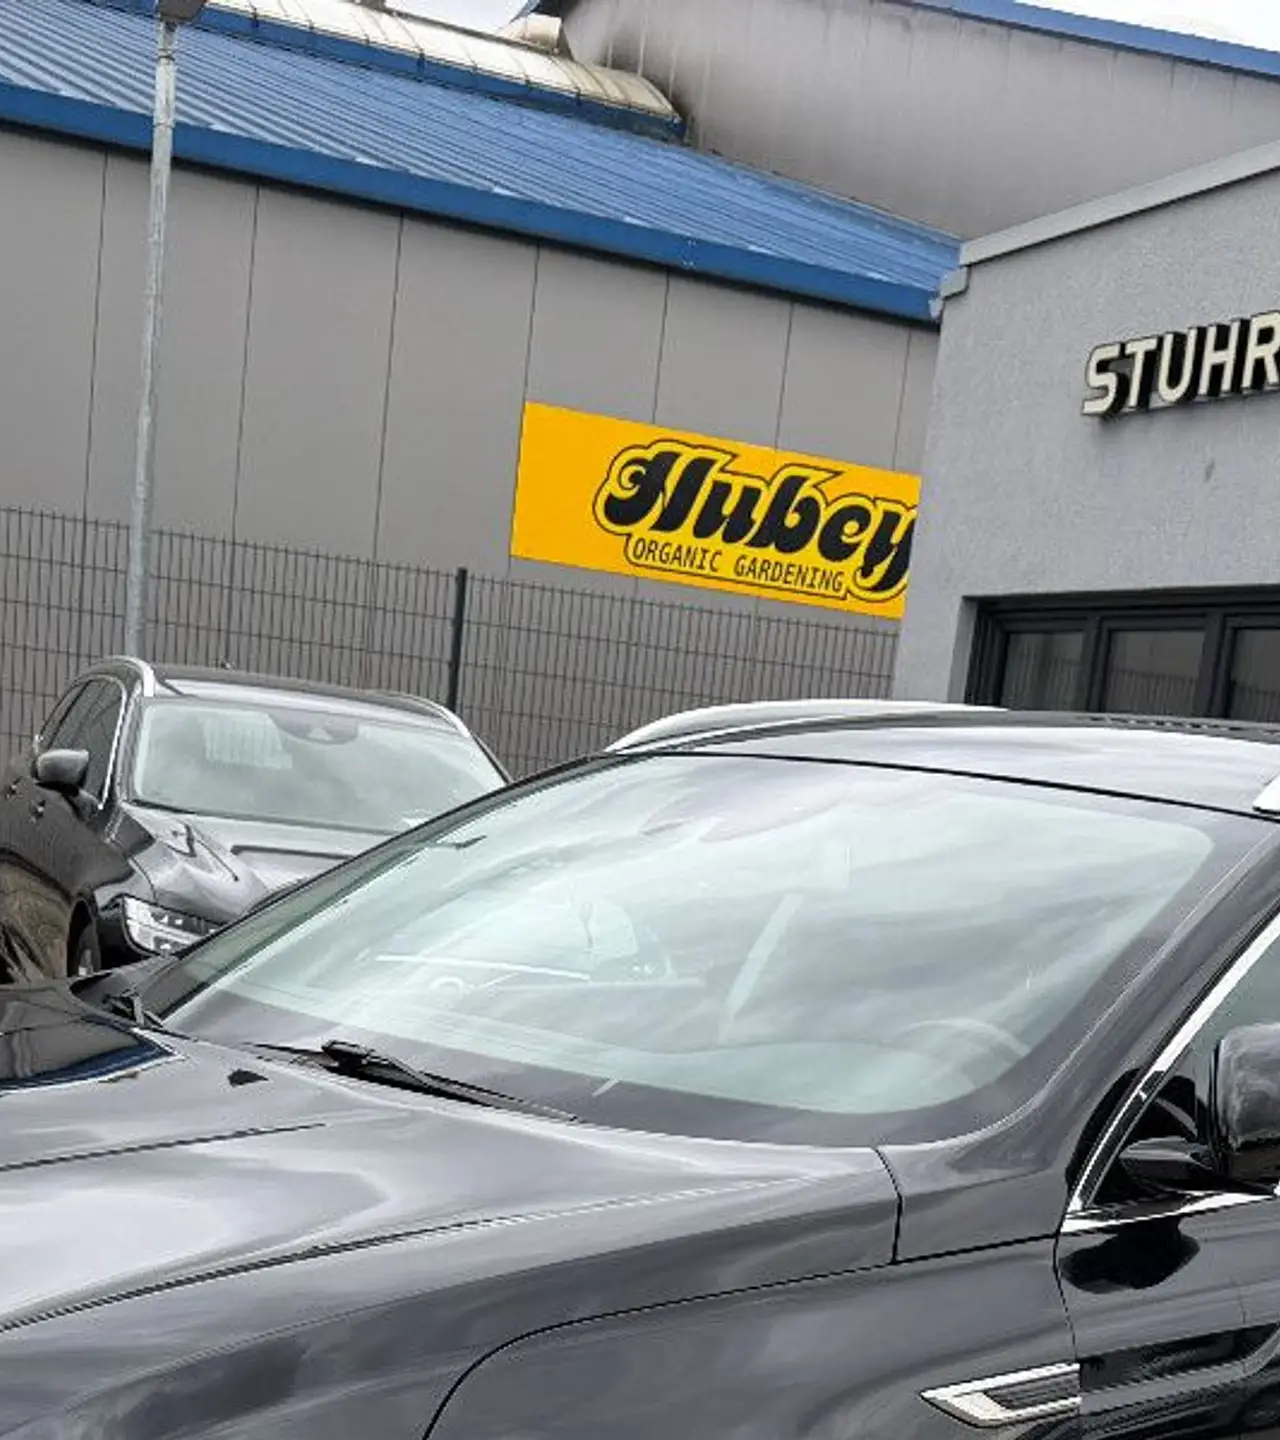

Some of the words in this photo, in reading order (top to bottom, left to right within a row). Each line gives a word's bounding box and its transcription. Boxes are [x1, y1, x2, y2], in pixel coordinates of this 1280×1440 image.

[603, 450, 917, 592] Hubey
[632, 536, 722, 572] ORGANIC
[734, 554, 846, 592] GARDENING
